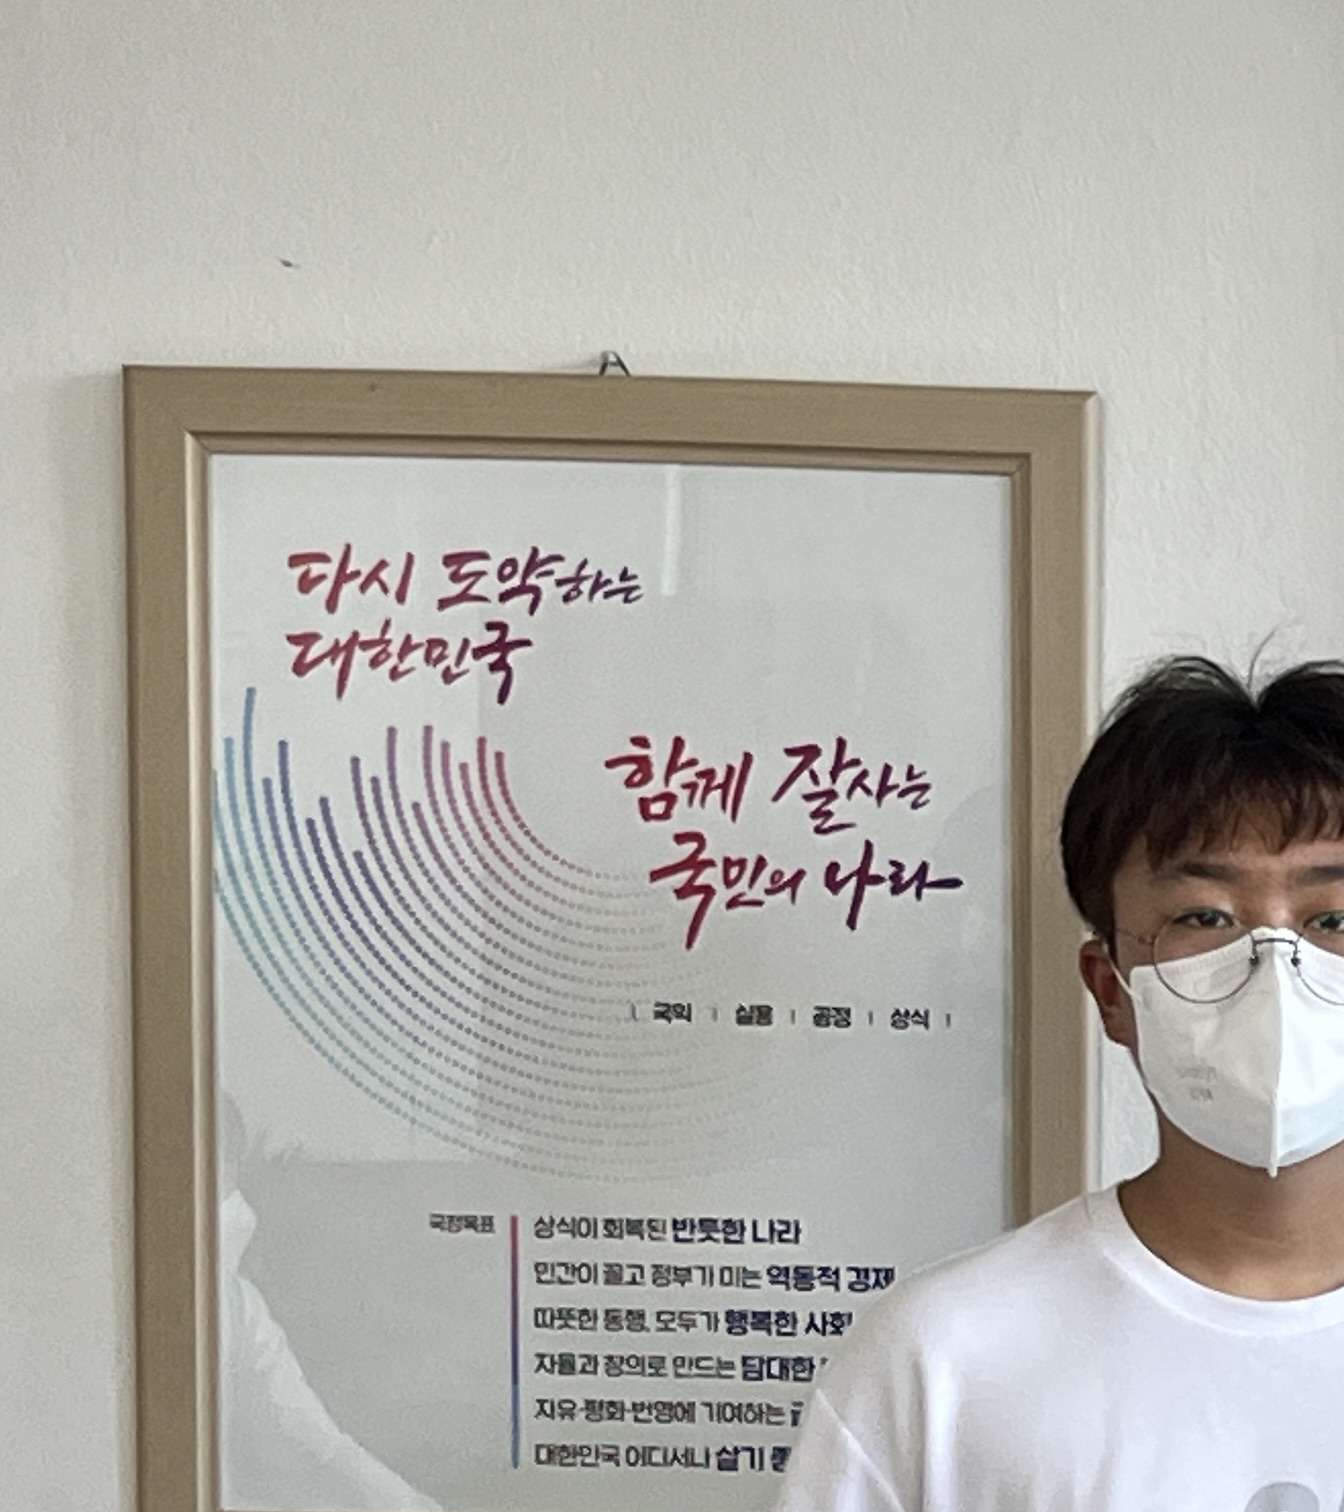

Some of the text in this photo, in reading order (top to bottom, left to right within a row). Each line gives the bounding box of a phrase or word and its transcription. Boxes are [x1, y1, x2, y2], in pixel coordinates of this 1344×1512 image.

[287, 542, 644, 617] 다시 도약하는
[285, 618, 533, 706] 대한민국
[605, 735, 932, 836] 함께 잘사는
[648, 831, 964, 950] 국민의 나라
[653, 1001, 692, 1024] 국익
[890, 1007, 930, 1031] 상식
[533, 1215, 802, 1245] 상식이 회복된 반듯한 나라
[533, 1261, 598, 1286] 민간이
[719, 1266, 763, 1289] 미는
[766, 1265, 841, 1292] 역동적
[533, 1307, 598, 1331] 따뜻한
[655, 1310, 719, 1333] 모두가
[725, 1309, 798, 1337] 행복한
[603, 1354, 668, 1378] 창의로
[672, 1355, 736, 1380] 만드는
[741, 1354, 816, 1382] 담대한
[701, 1401, 786, 1426] 기여하는
[534, 1443, 620, 1468] 대한민국
[716, 1445, 765, 1472] 살기
